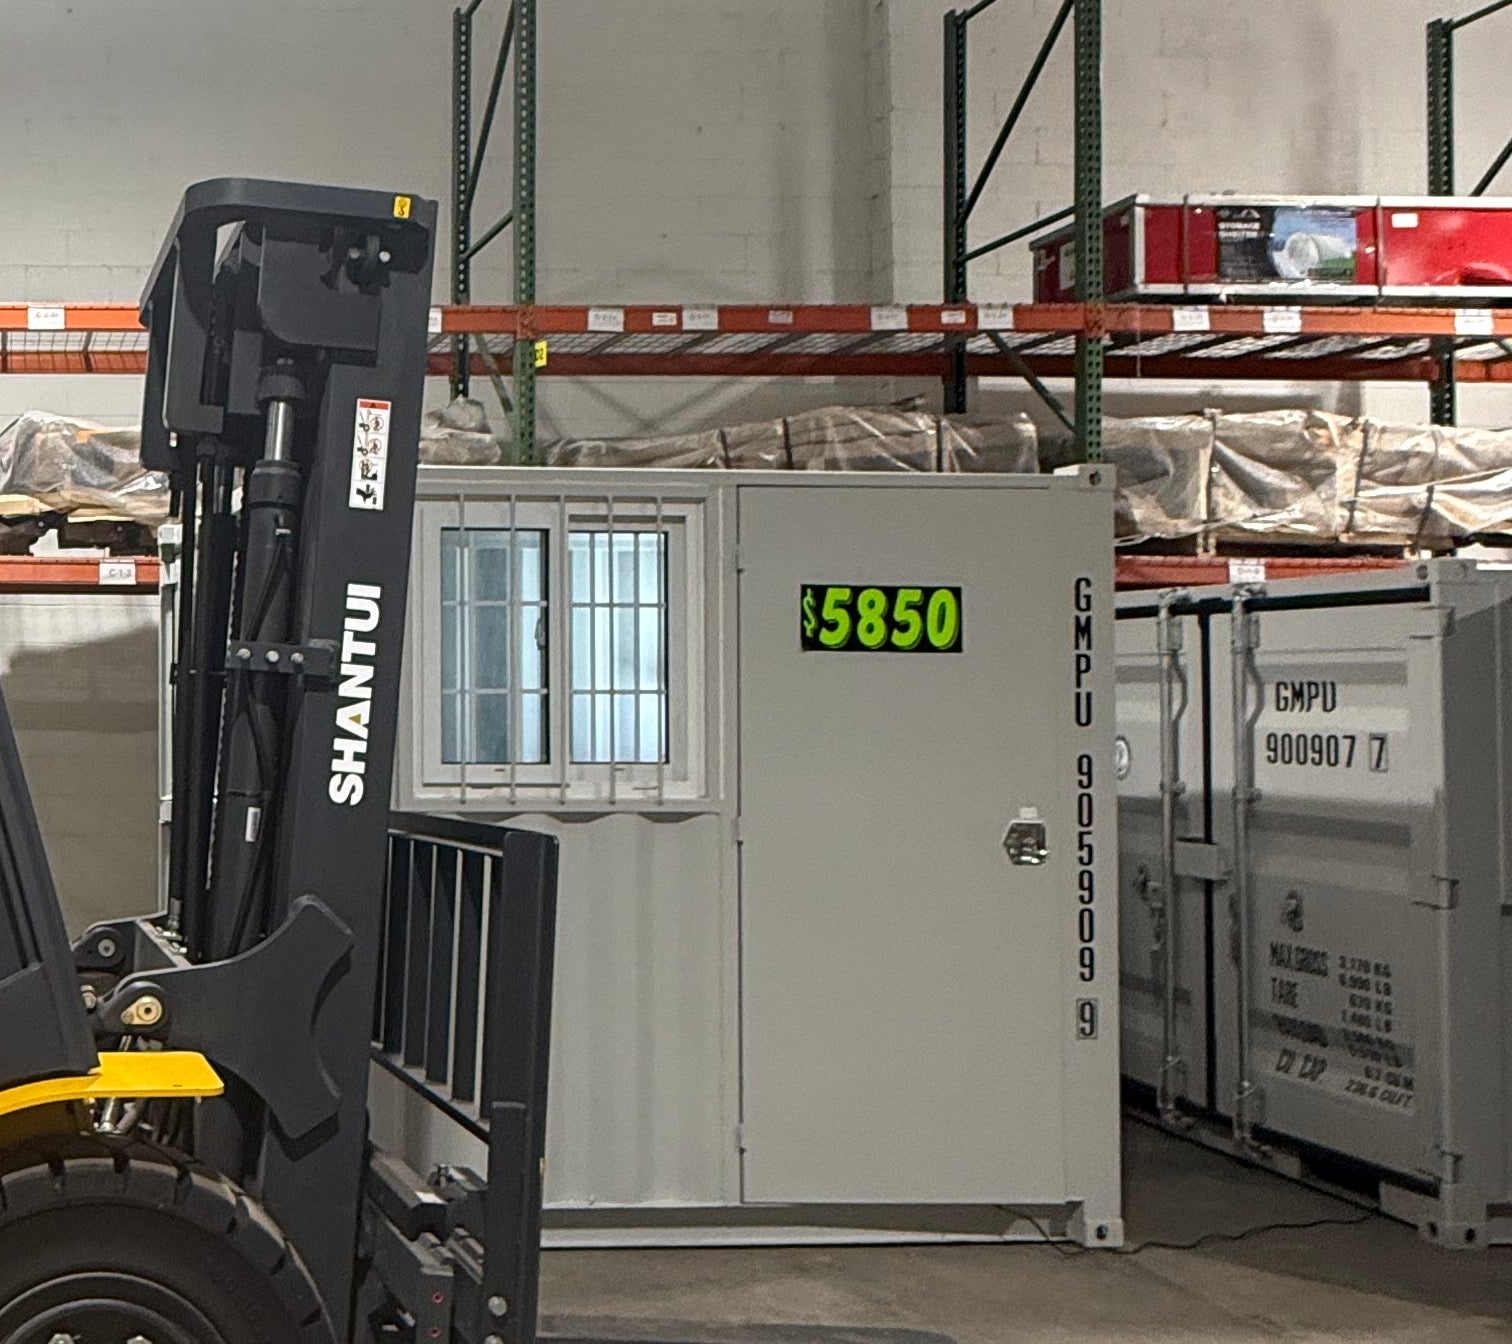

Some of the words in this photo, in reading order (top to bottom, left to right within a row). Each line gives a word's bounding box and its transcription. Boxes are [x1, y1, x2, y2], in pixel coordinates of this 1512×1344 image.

[803, 588, 960, 649] $5850
[1074, 577, 1093, 728] GMPU
[329, 583, 381, 806] SHANTUI
[1275, 681, 1337, 713] GMPU
[1266, 732, 1356, 768] 900907
[1369, 735, 1386, 770] 7
[1076, 753, 1095, 983] 905909
[1079, 999, 1096, 1038] 9
